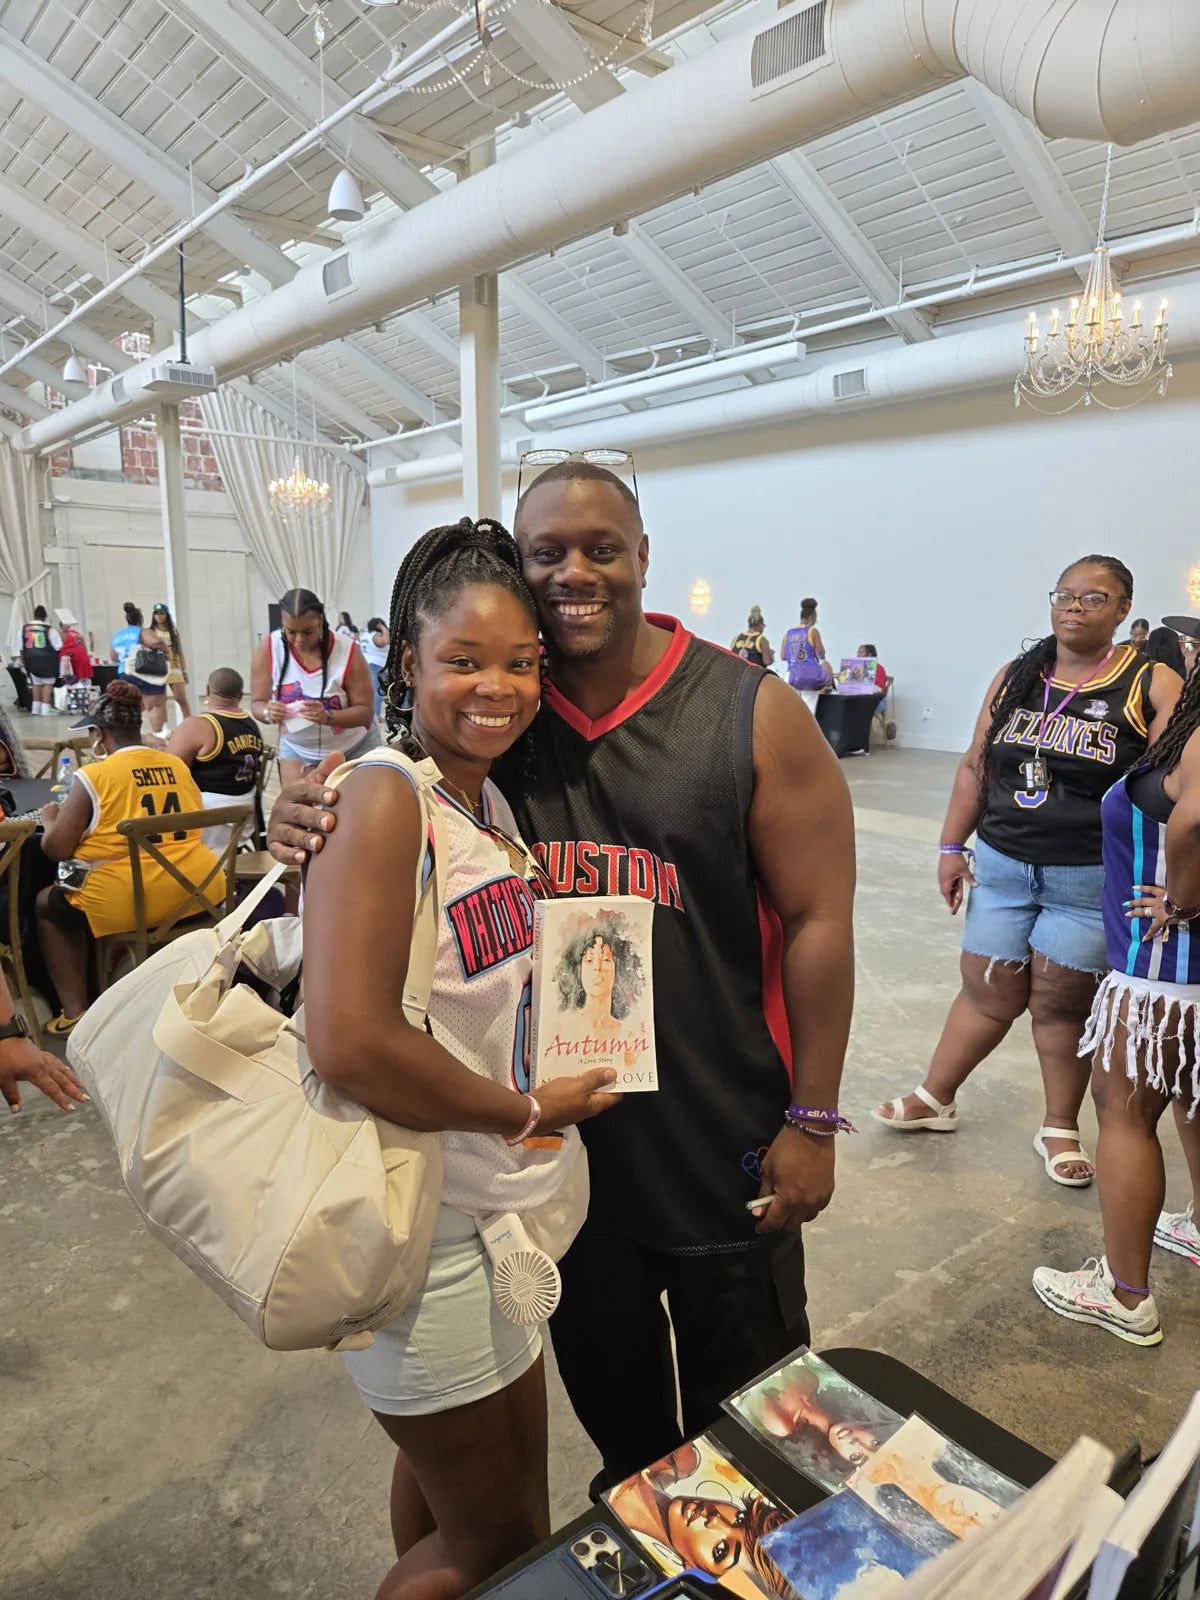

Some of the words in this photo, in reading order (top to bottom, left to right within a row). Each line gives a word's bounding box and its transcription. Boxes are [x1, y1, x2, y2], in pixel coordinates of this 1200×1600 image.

[25, 632, 46, 648] 70
[227, 734, 263, 754] DANIELS
[994, 708, 1118, 765] CLONES
[132, 766, 177, 787] SMITH
[141, 792, 187, 843] 14
[544, 1034, 649, 1057] Autumn
[598, 1057, 614, 1065] Story
